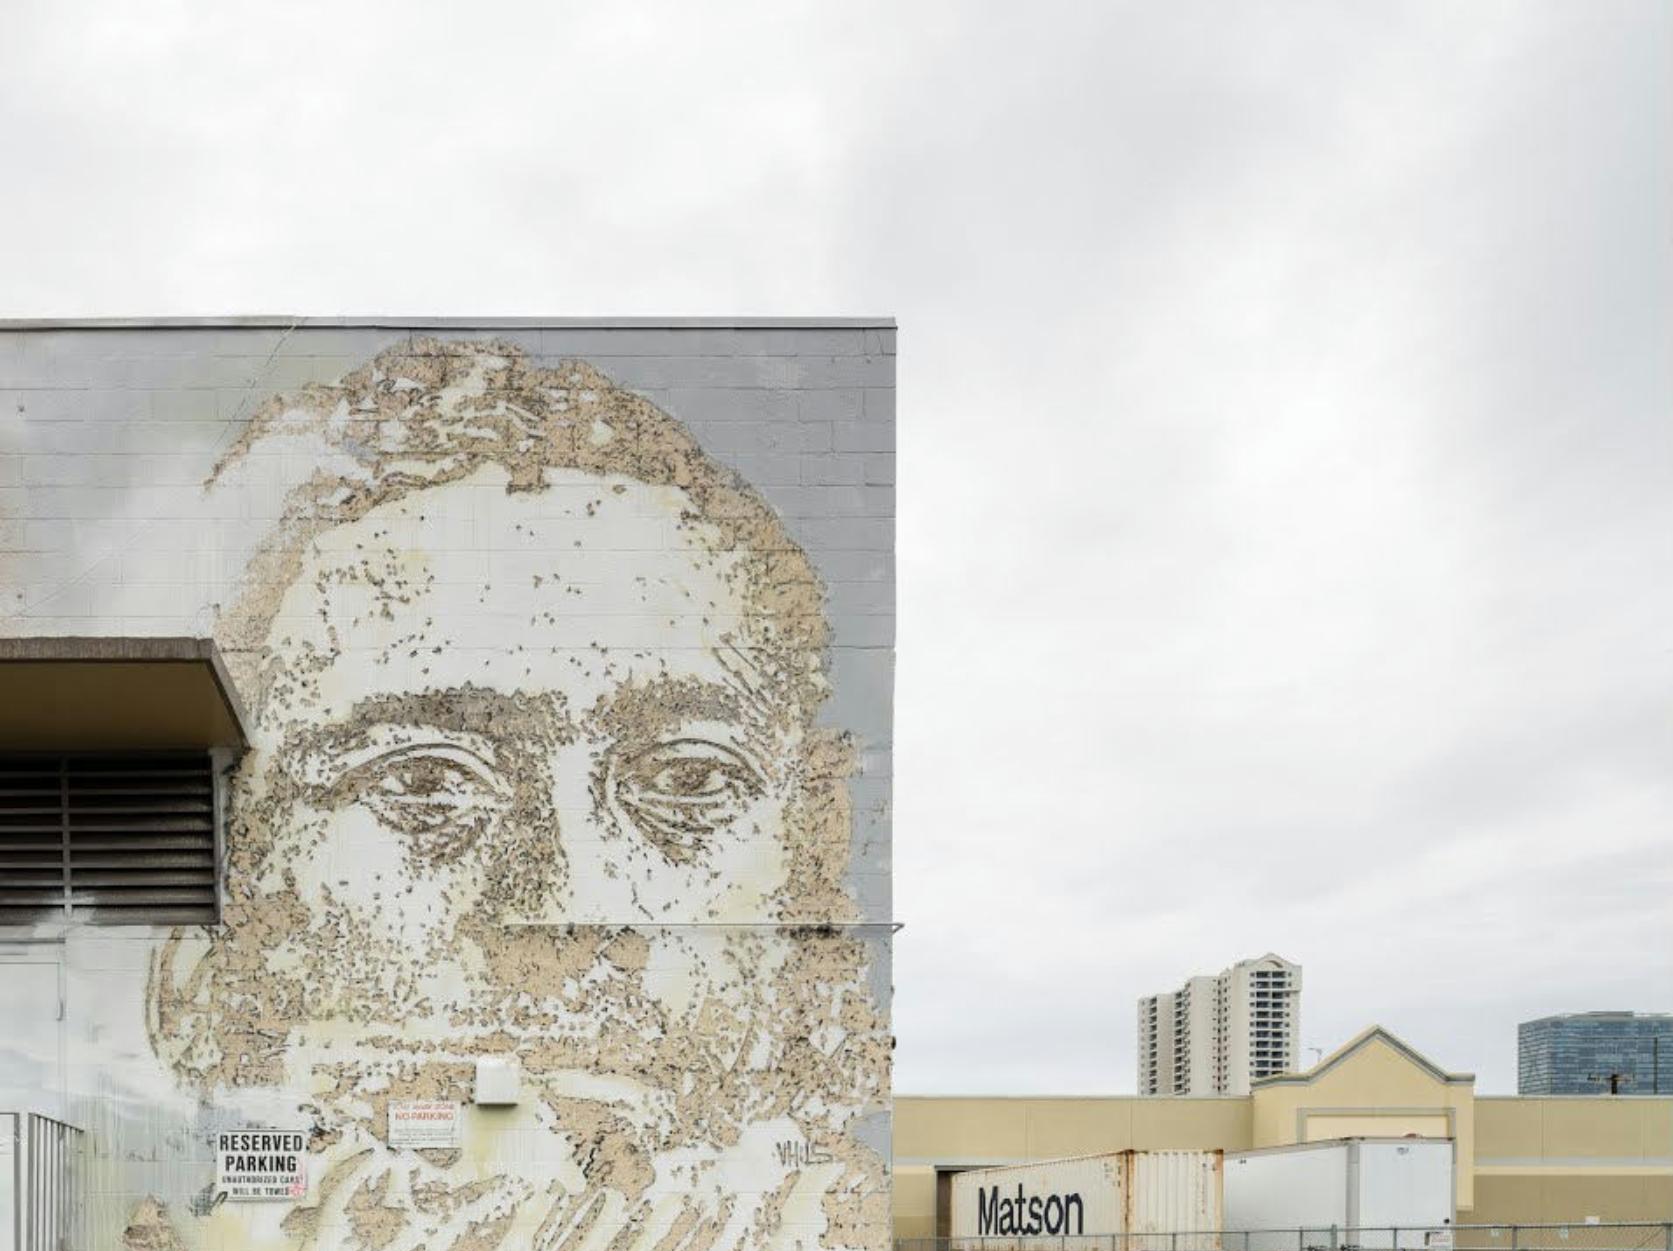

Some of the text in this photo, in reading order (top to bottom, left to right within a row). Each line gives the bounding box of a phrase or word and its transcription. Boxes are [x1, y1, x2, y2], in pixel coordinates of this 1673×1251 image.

[220, 1135, 303, 1151] RESERVED
[225, 1155, 296, 1172] PARKING
[979, 1183, 1083, 1235] Matson
